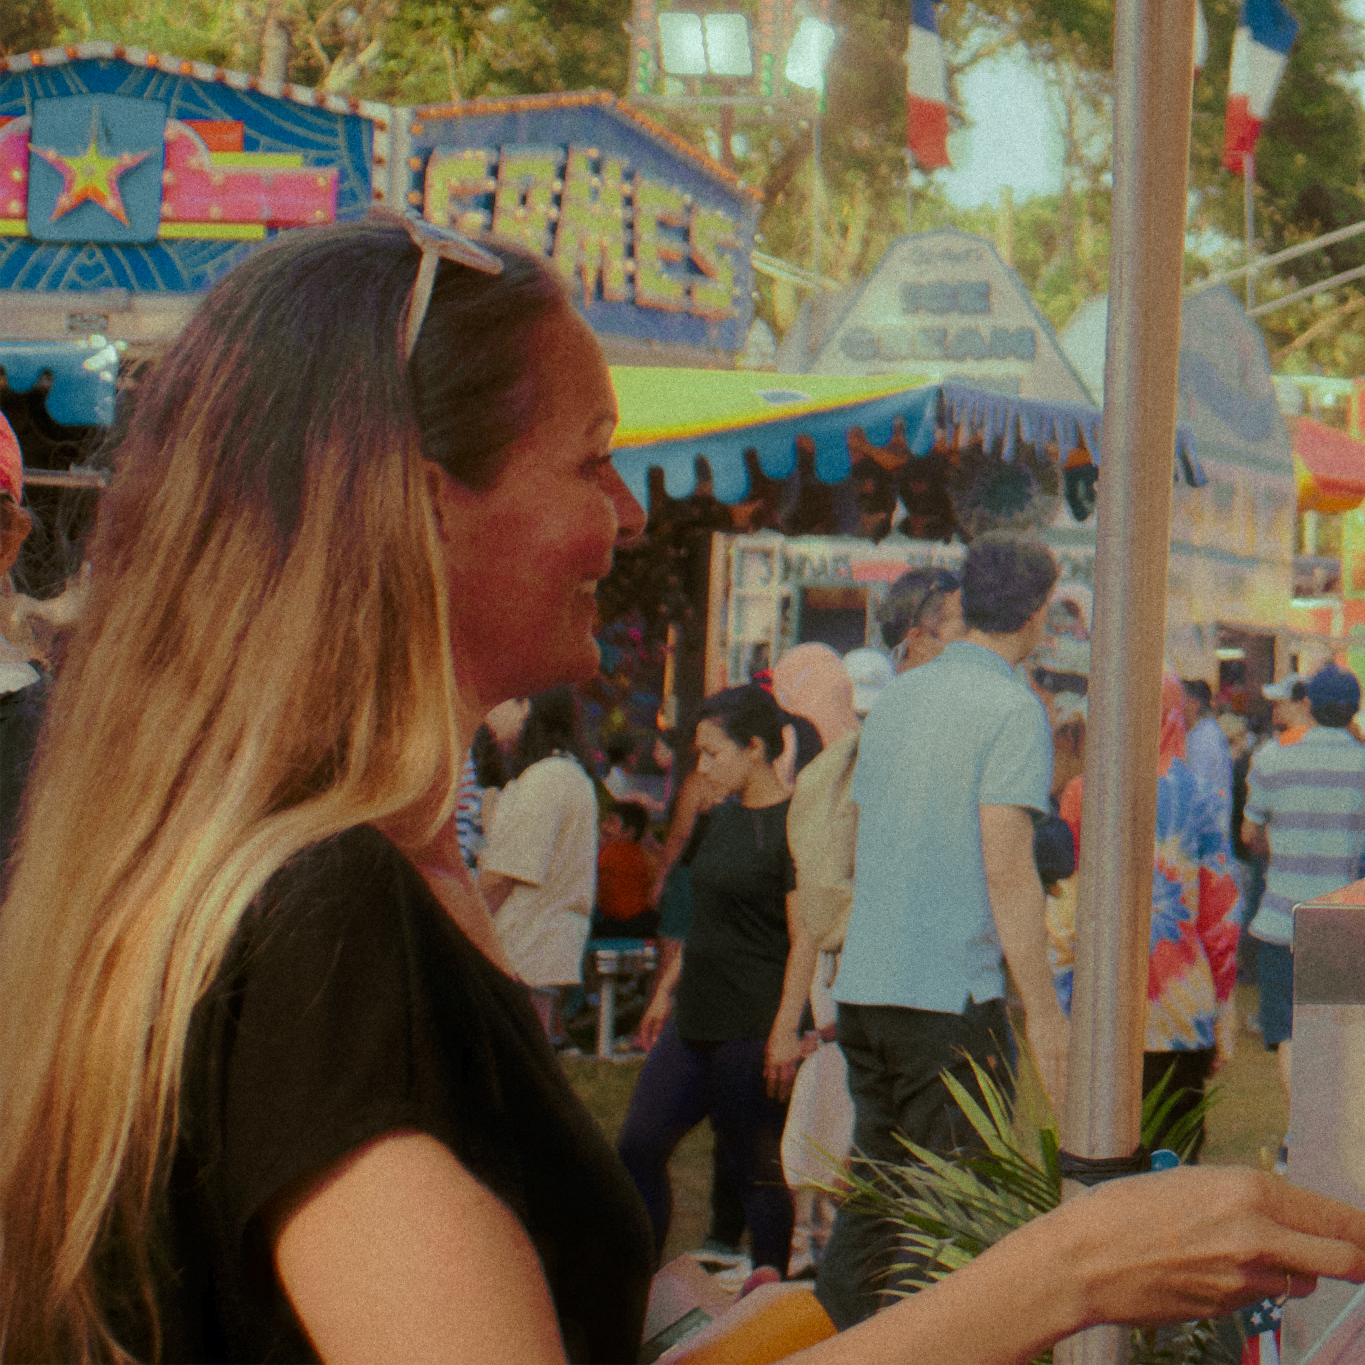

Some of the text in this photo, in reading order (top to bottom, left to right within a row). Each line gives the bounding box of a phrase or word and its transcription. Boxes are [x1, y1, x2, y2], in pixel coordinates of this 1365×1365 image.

[424, 142, 740, 321] GAMES
[901, 281, 990, 314] ICE
[839, 324, 1036, 361] CREAM
